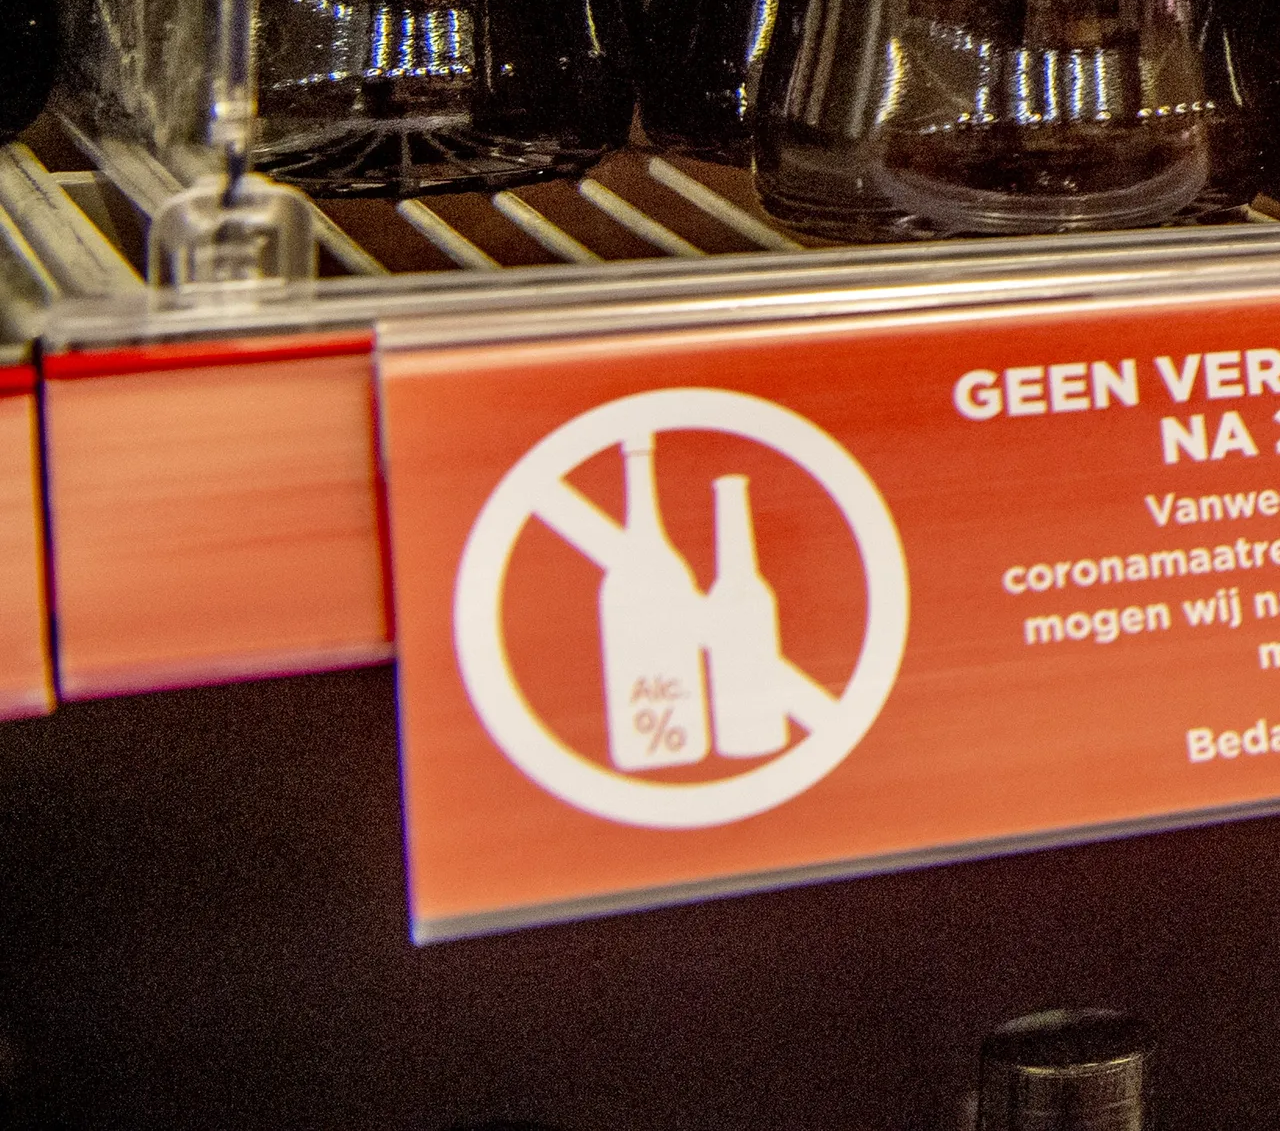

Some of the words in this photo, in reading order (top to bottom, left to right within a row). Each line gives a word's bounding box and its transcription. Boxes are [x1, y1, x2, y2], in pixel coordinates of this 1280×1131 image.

[953, 358, 1140, 421] GEEN
[1160, 410, 1259, 465] NA
[1023, 600, 1170, 647] mogen
[1183, 586, 1243, 630] wij
